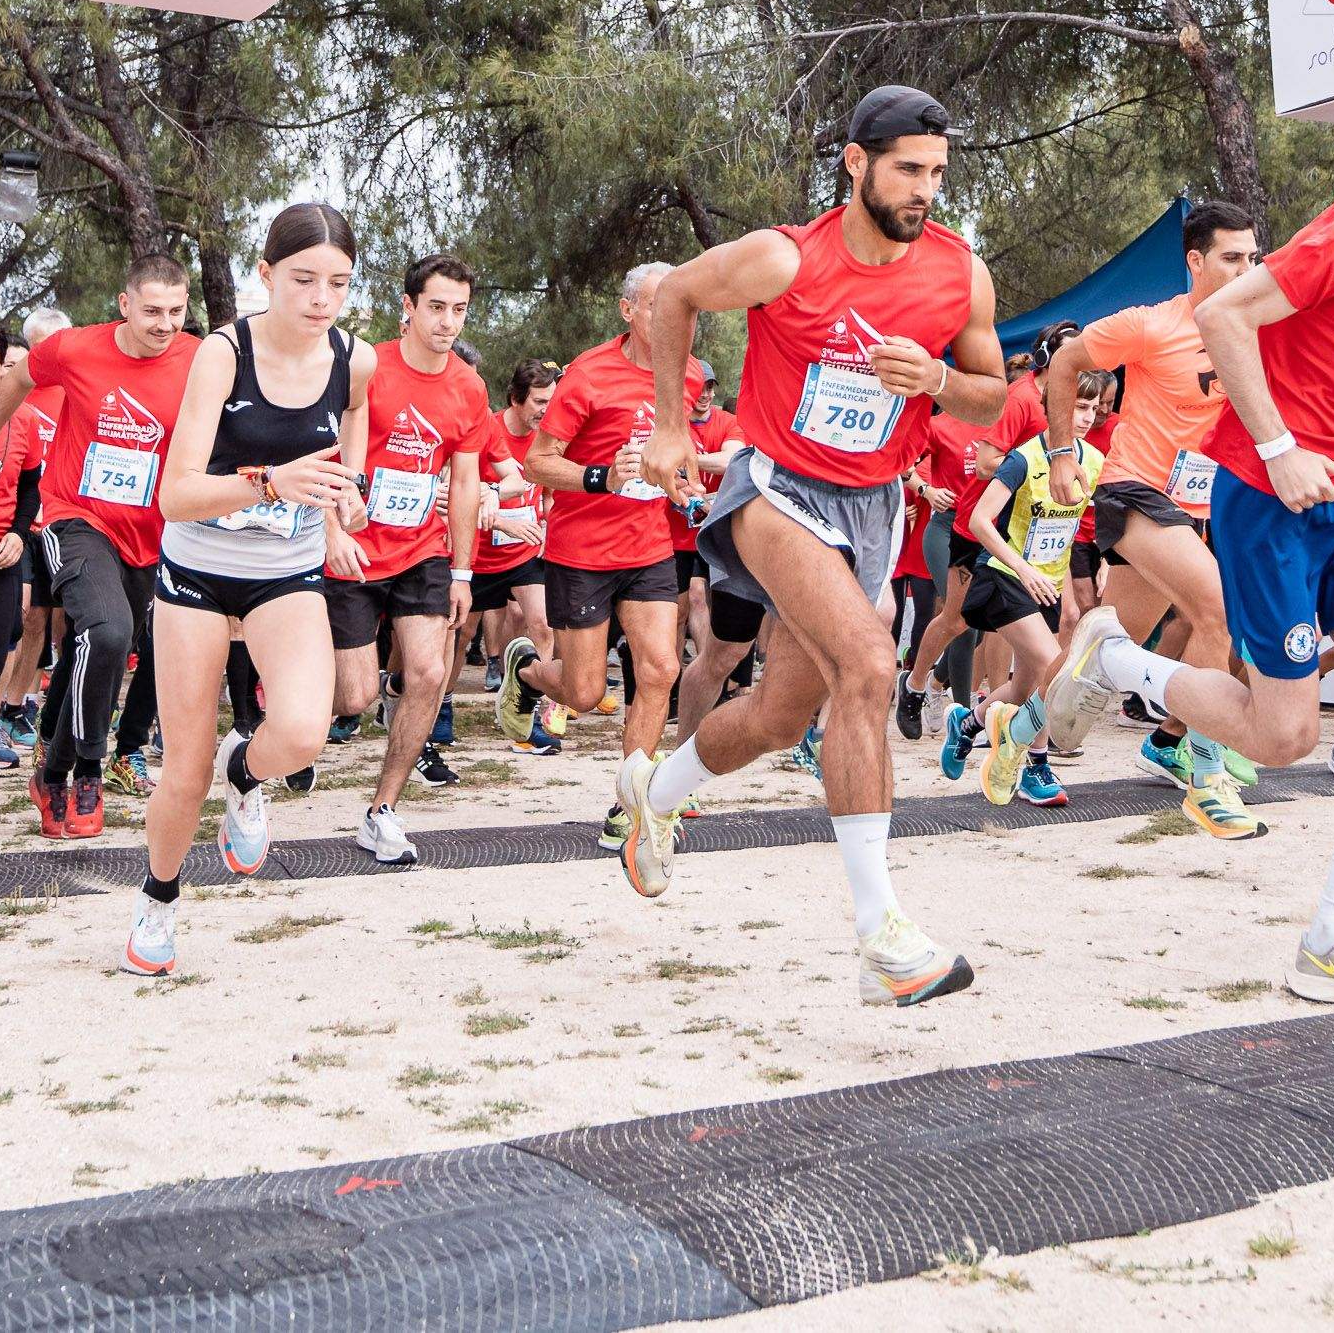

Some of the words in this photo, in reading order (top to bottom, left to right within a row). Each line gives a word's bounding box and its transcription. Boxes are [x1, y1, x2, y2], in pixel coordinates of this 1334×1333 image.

[821, 381, 881, 397] ENFERMEDADES
[825, 405, 876, 431] 780
[101, 469, 137, 489] 754
[385, 495, 421, 512] 557
[1040, 538, 1065, 549] 516
